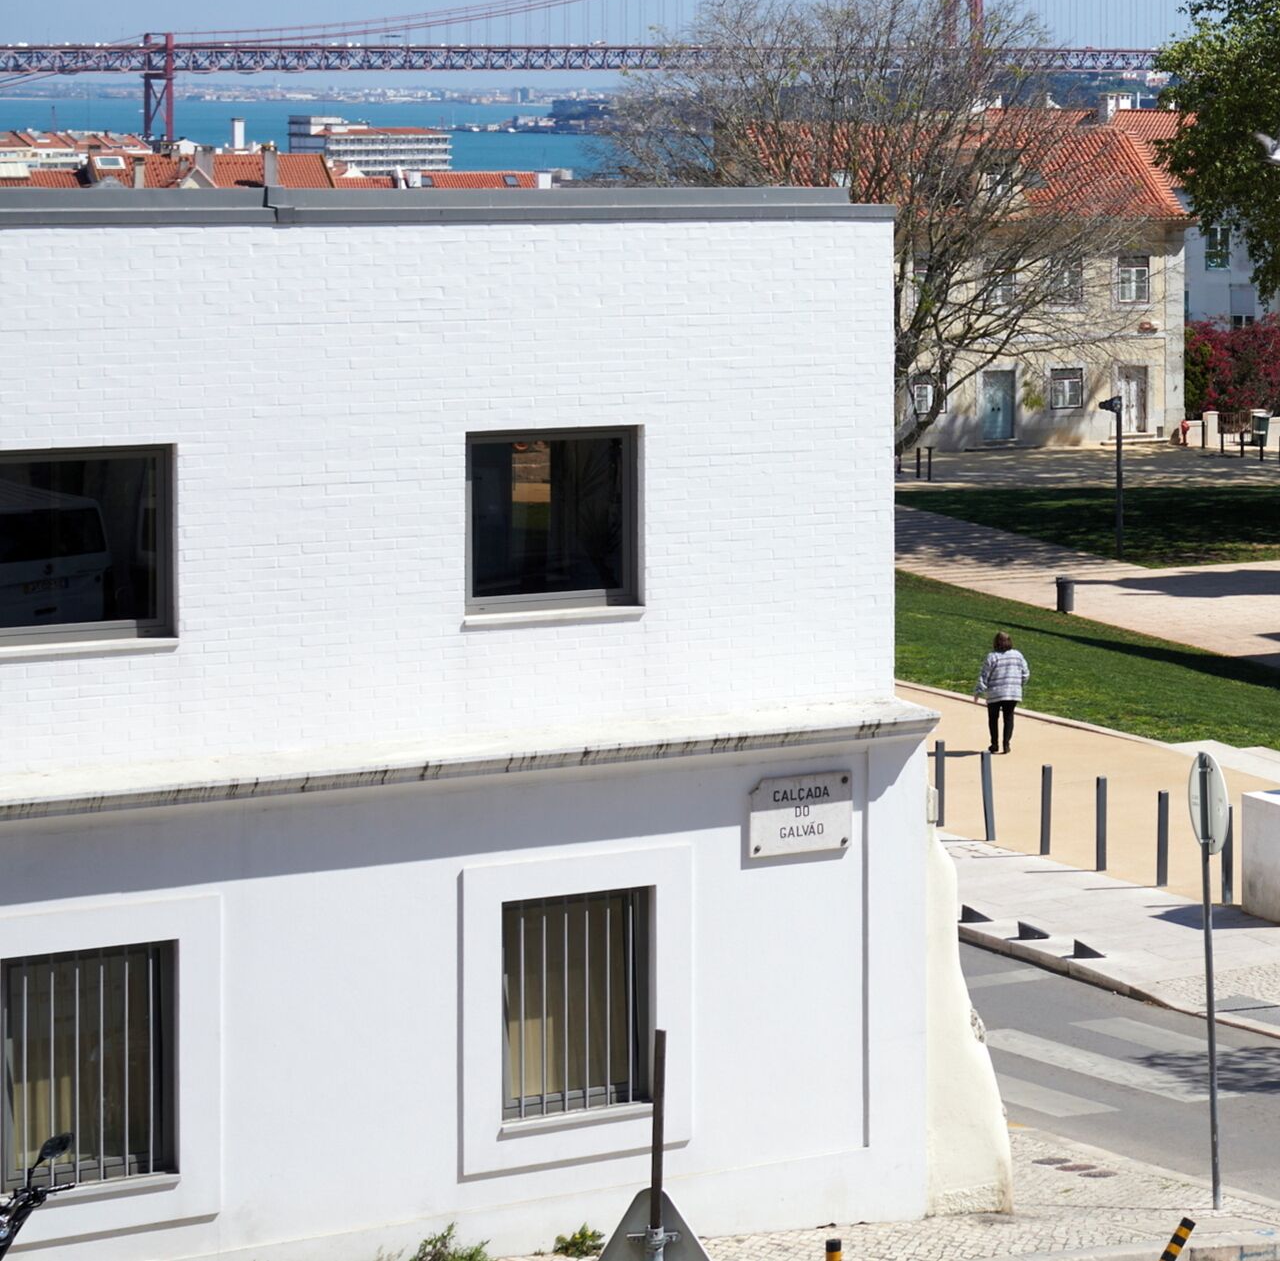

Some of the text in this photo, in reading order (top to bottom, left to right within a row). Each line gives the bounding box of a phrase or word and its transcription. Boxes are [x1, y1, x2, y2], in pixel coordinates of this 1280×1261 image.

[773, 786, 830, 802] CALÇADA
[795, 805, 810, 818] DO
[779, 822, 824, 839] GALVÃO
